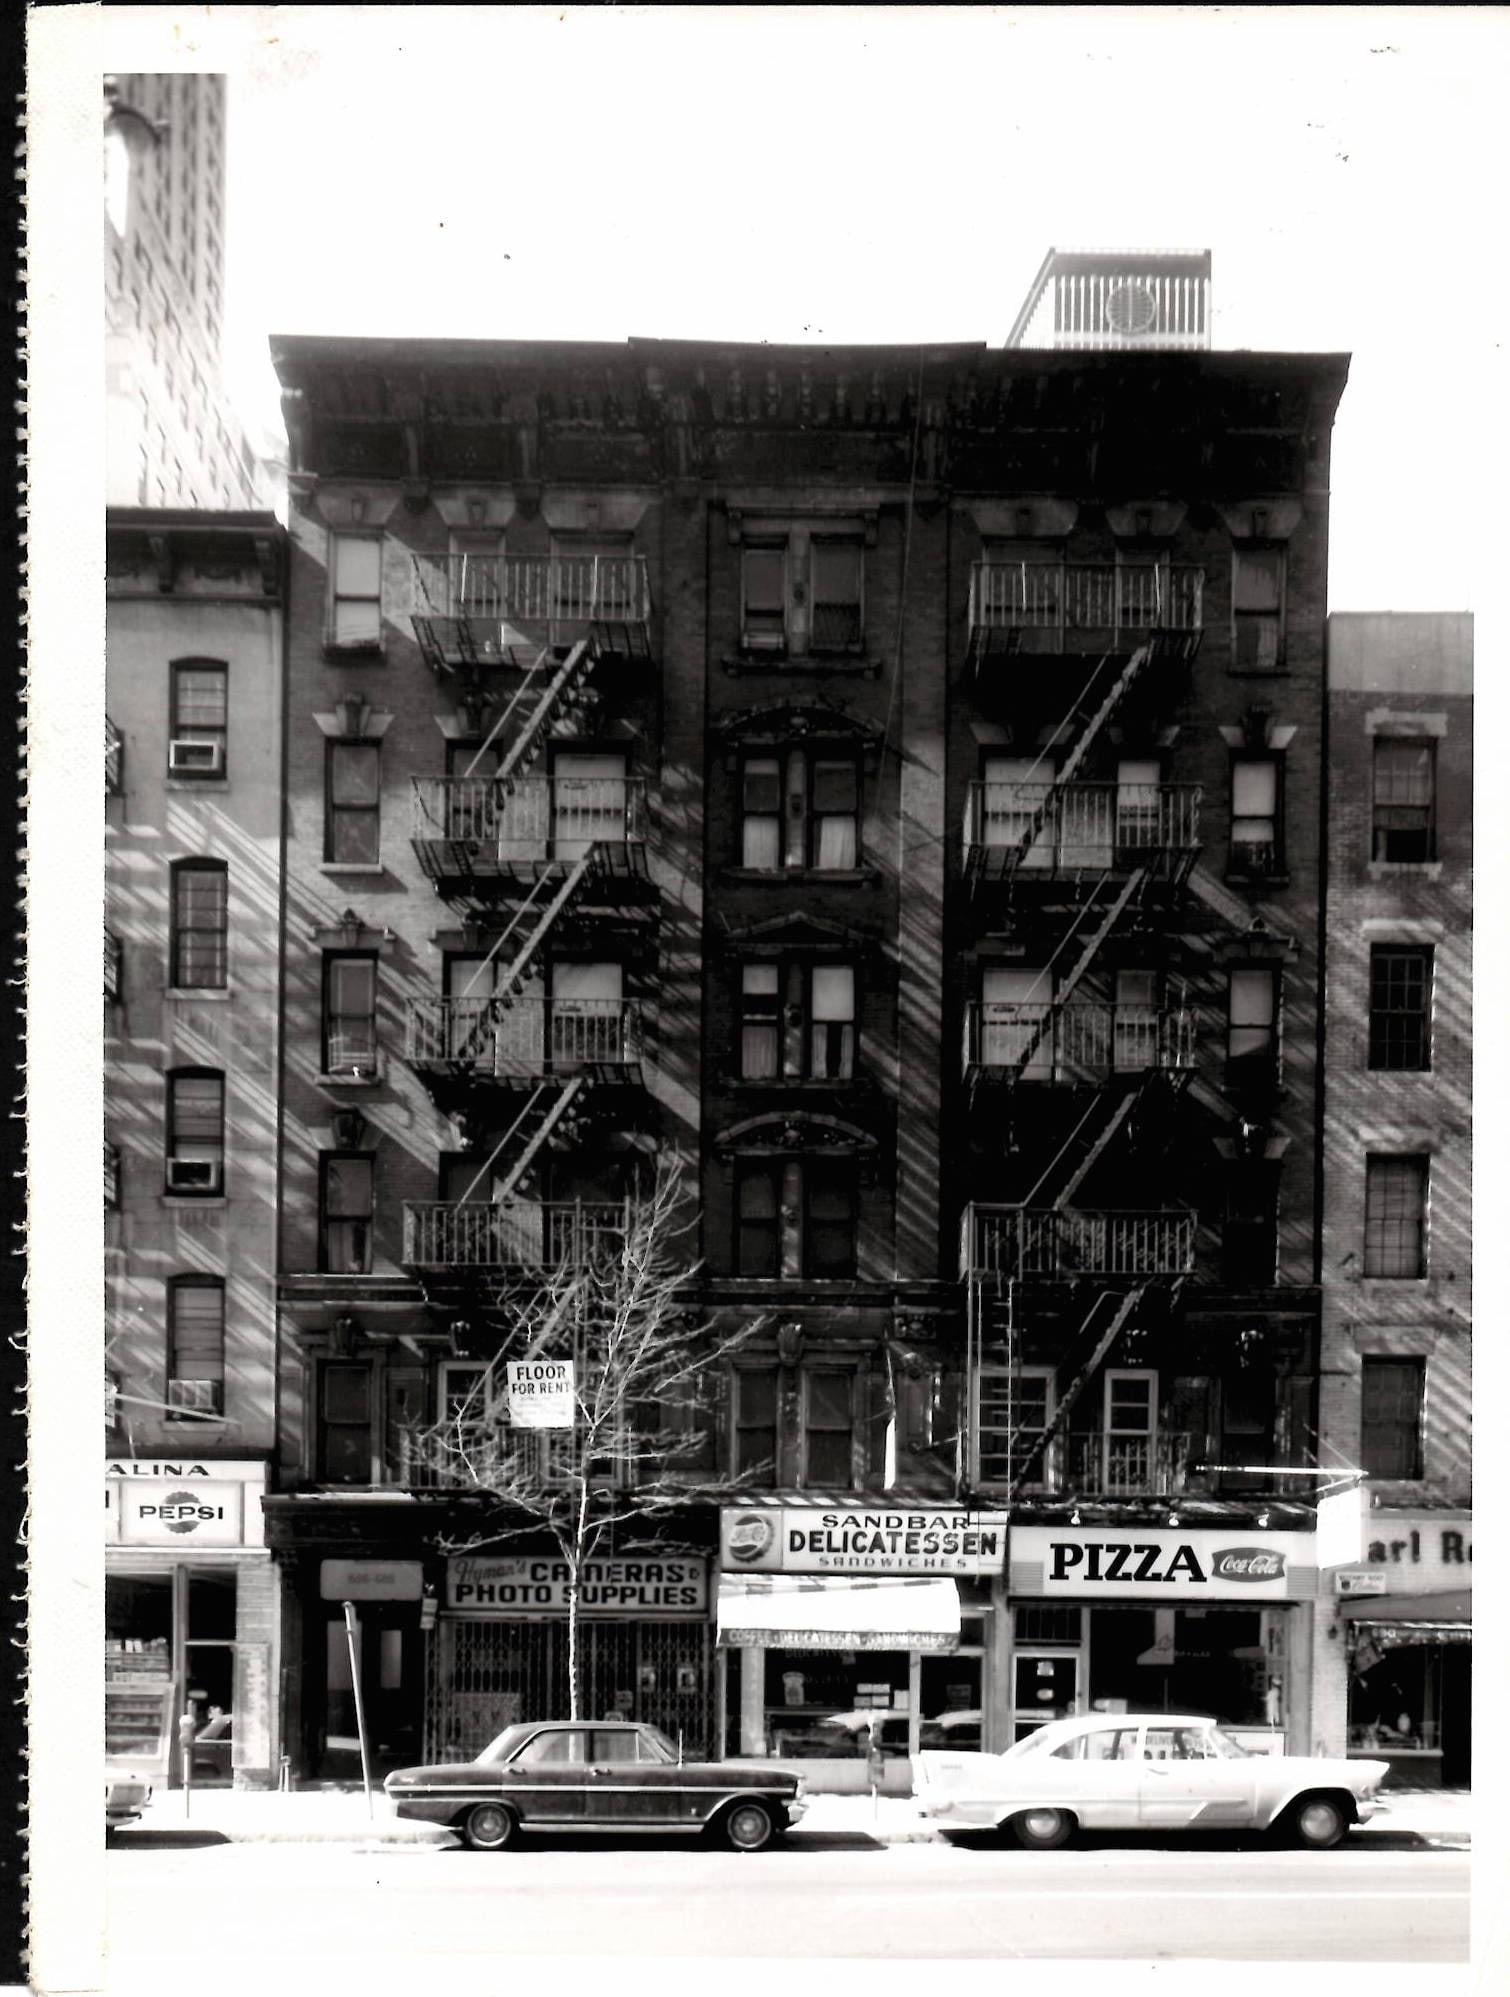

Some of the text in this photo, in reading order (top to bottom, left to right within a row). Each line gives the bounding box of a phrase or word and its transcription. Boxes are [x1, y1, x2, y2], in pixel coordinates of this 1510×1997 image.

[516, 1365, 566, 1380] FLOOR
[511, 1381, 570, 1395] FOR RENT
[106, 1463, 210, 1477] ALINA
[139, 1505, 224, 1520] PEPSI
[821, 1514, 969, 1530] SANDBAR
[788, 1529, 997, 1556] DELICATESSEN
[1441, 1530, 1472, 1564] R
[818, 1556, 968, 1569] SANDWICHES
[1048, 1542, 1280, 1583] PIZZA Coca-Cola
[455, 1583, 552, 1604] PHOTO
